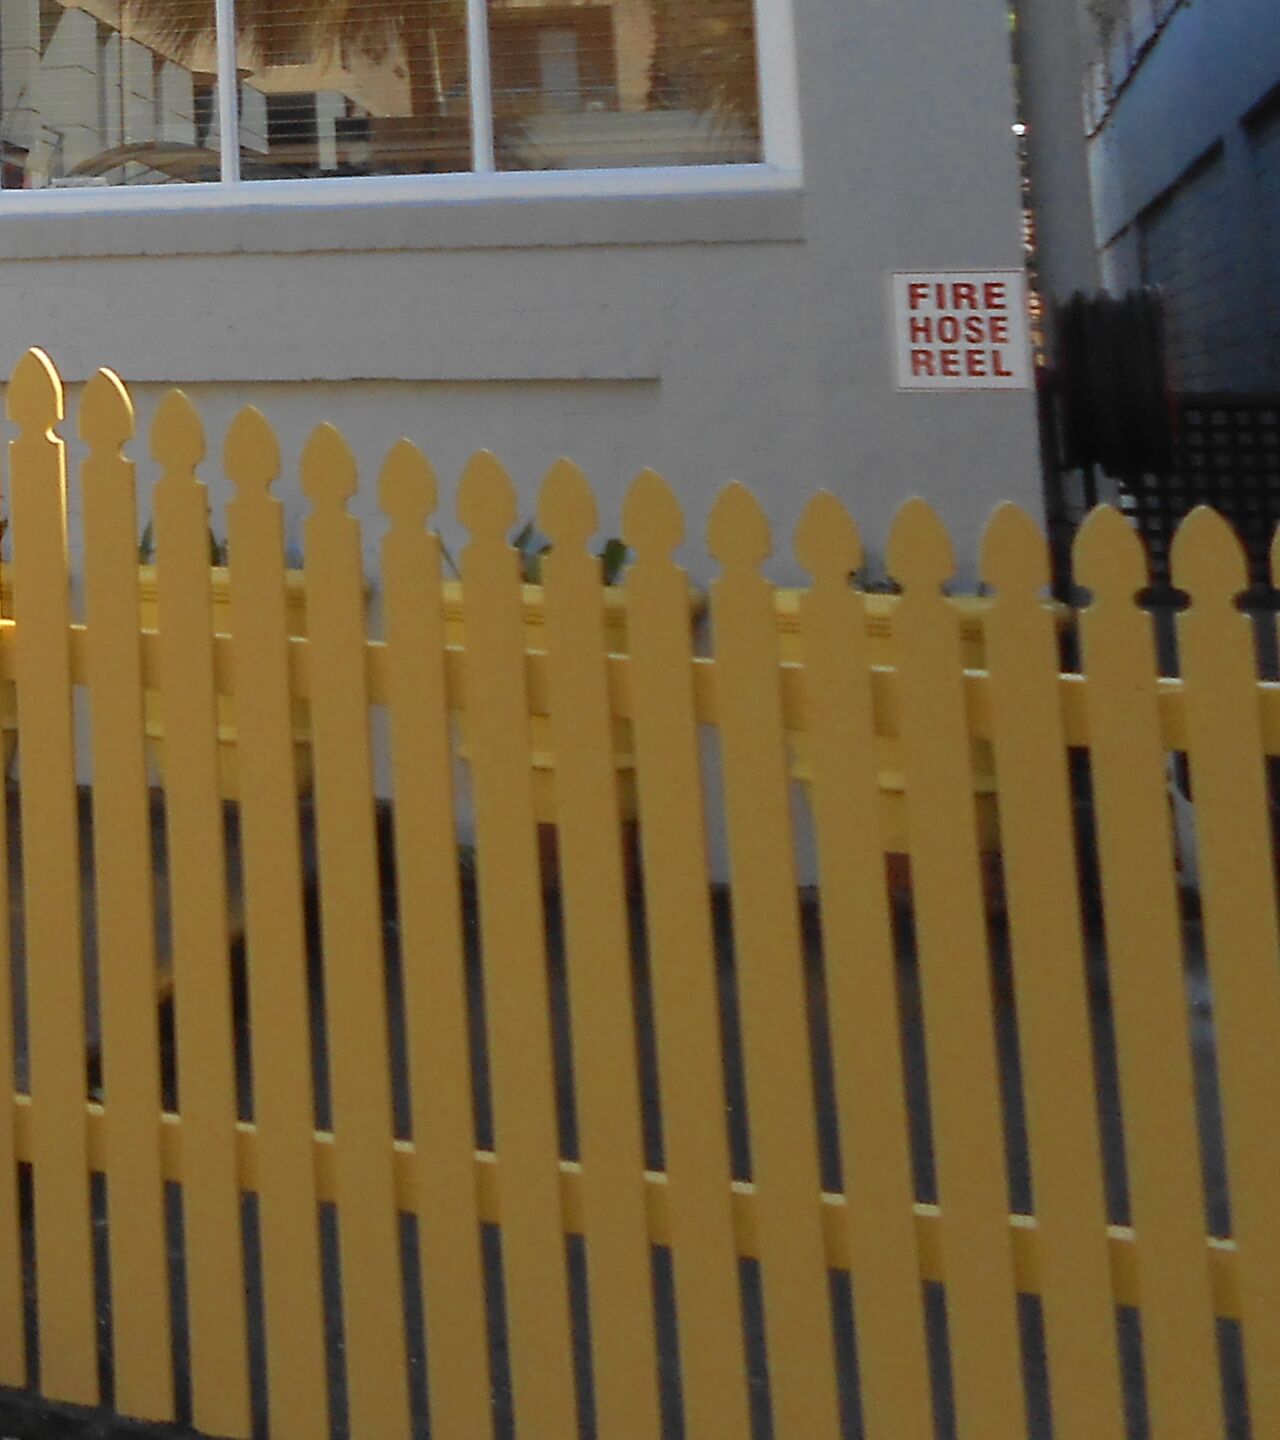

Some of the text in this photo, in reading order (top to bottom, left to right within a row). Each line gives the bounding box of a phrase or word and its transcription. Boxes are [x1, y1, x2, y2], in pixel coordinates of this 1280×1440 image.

[907, 282, 1007, 310] FIRE
[909, 315, 1010, 344] HOSE
[911, 348, 1013, 377] REEL
